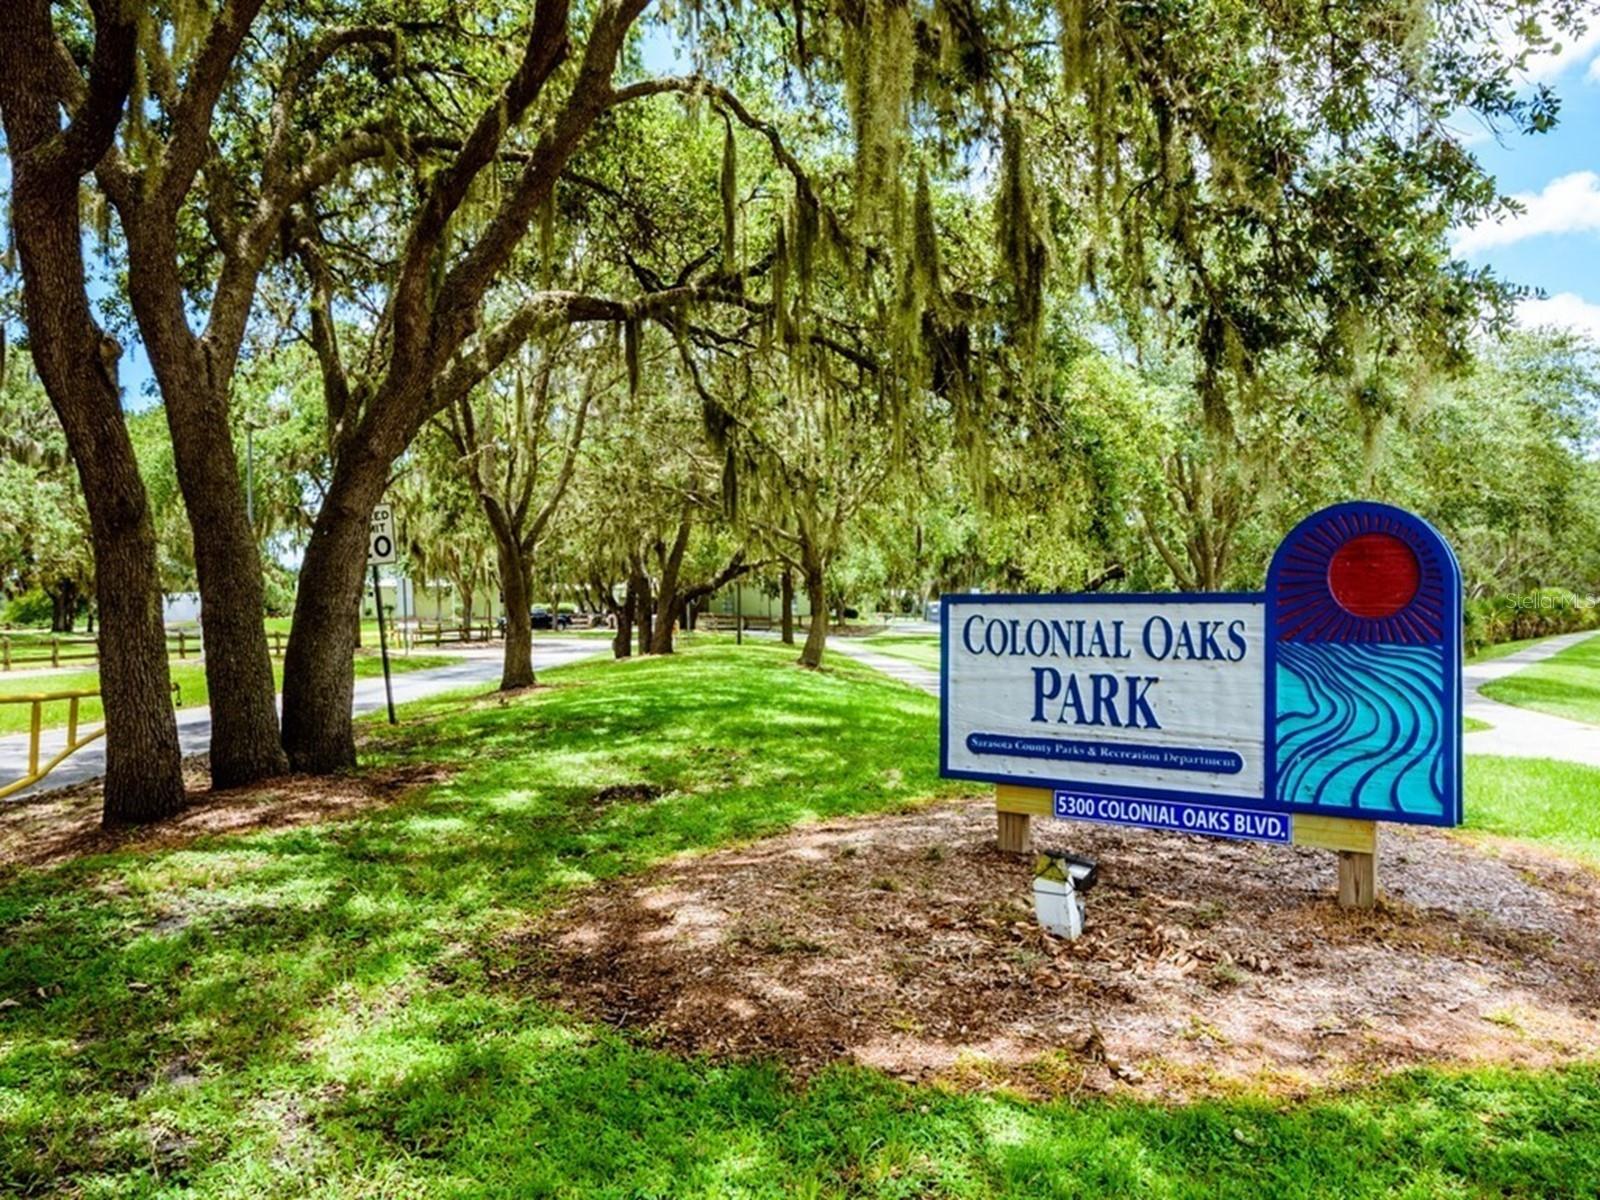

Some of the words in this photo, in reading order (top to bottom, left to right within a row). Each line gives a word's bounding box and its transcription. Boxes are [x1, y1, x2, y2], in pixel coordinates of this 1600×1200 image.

[368, 535, 391, 558] 0
[962, 614, 1131, 658] COLONIAL
[1142, 615, 1247, 663] OAKS
[1030, 666, 1162, 730] PARK
[971, 737, 1013, 750] Sarasota
[1015, 740, 1052, 754] County
[1055, 743, 1085, 756] Parks
[1087, 746, 1097, 757] &
[1100, 747, 1160, 761] Recreation
[1164, 752, 1236, 767] Department
[1058, 796, 1095, 817] 5300
[1098, 799, 1179, 825] COLONIAL
[1182, 808, 1230, 831] OAKS
[1233, 814, 1286, 837] BLVD.
